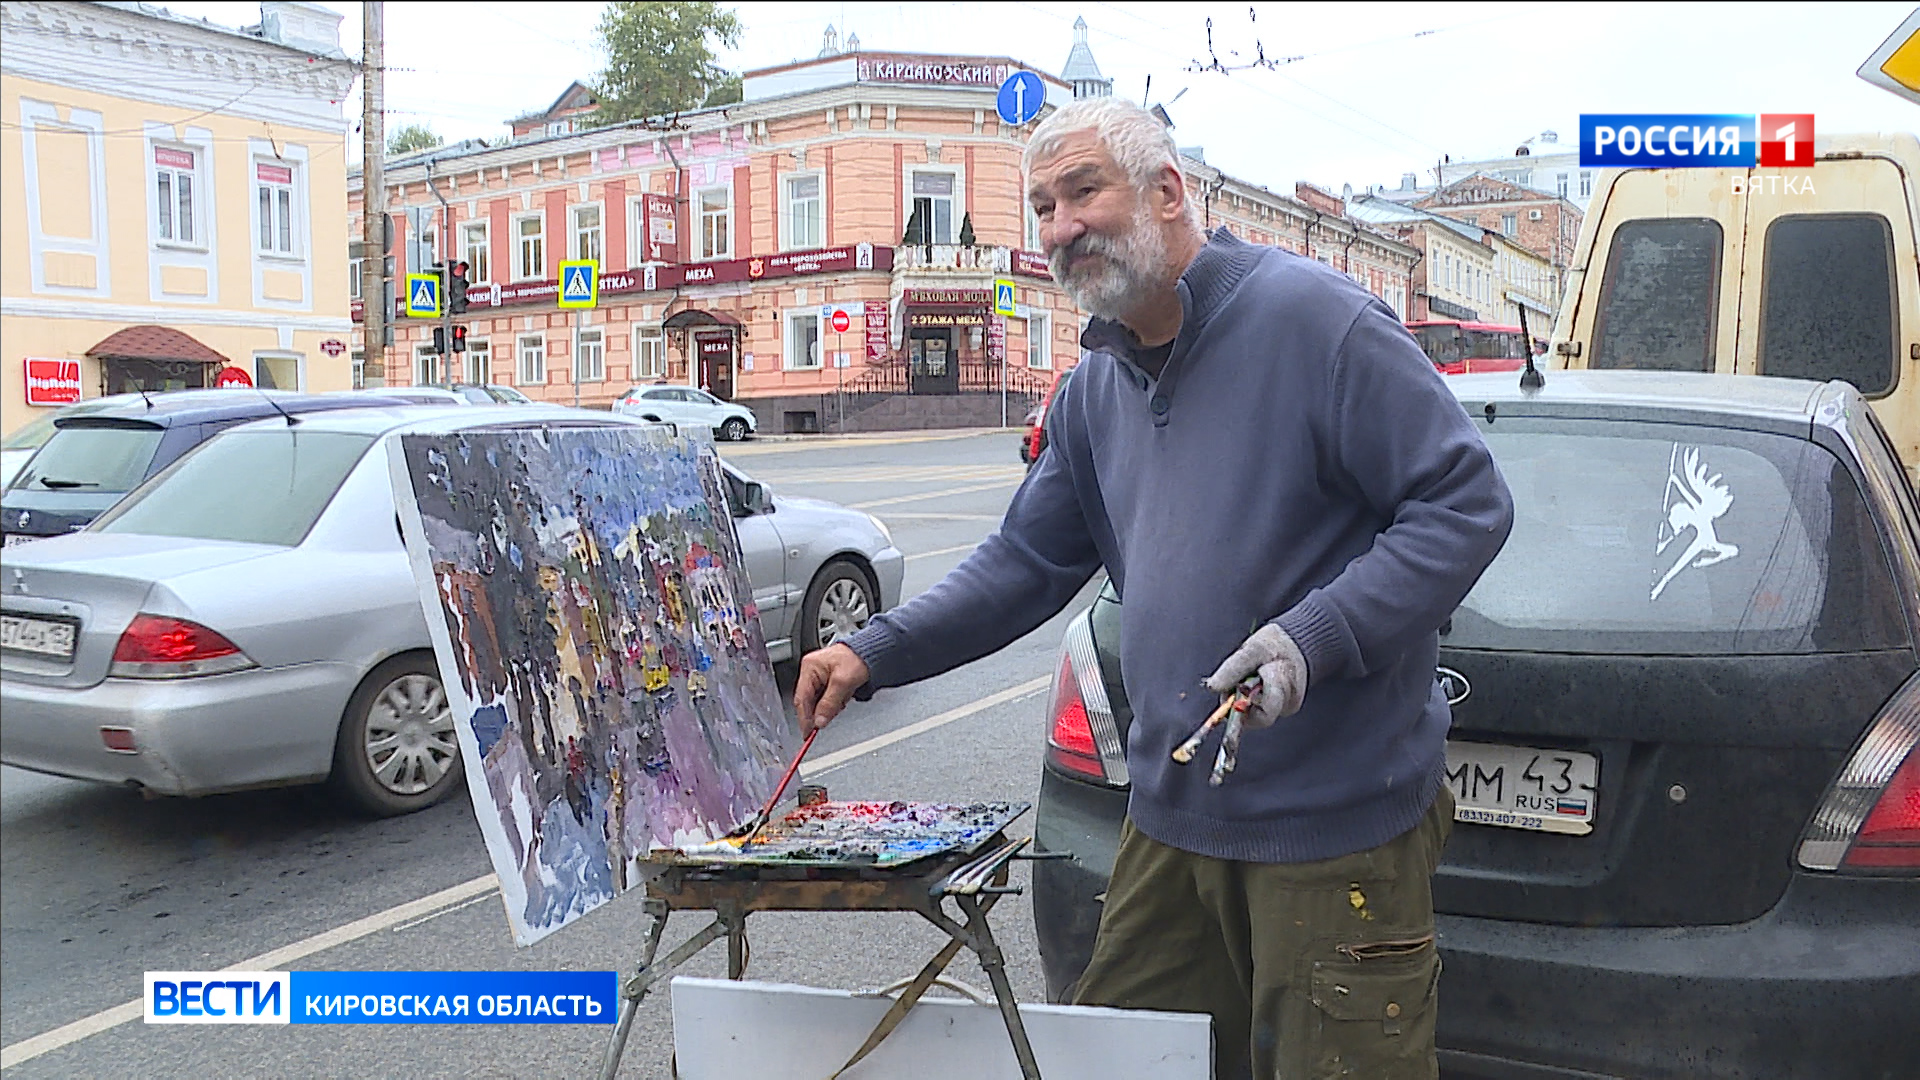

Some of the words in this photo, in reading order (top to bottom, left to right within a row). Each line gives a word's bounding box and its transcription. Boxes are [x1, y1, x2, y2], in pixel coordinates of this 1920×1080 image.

[685, 267, 715, 281] МЕХА
[910, 291, 960, 303] МЕХОВАЯ
[963, 291, 991, 304] МОДА
[911, 315, 918, 325] 2
[919, 315, 954, 325] ЭТАЖА
[956, 315, 984, 325] МЕХА
[704, 343, 728, 352] МЕХА
[1522, 755, 1573, 794] 43
[1515, 795, 1555, 811] RUS
